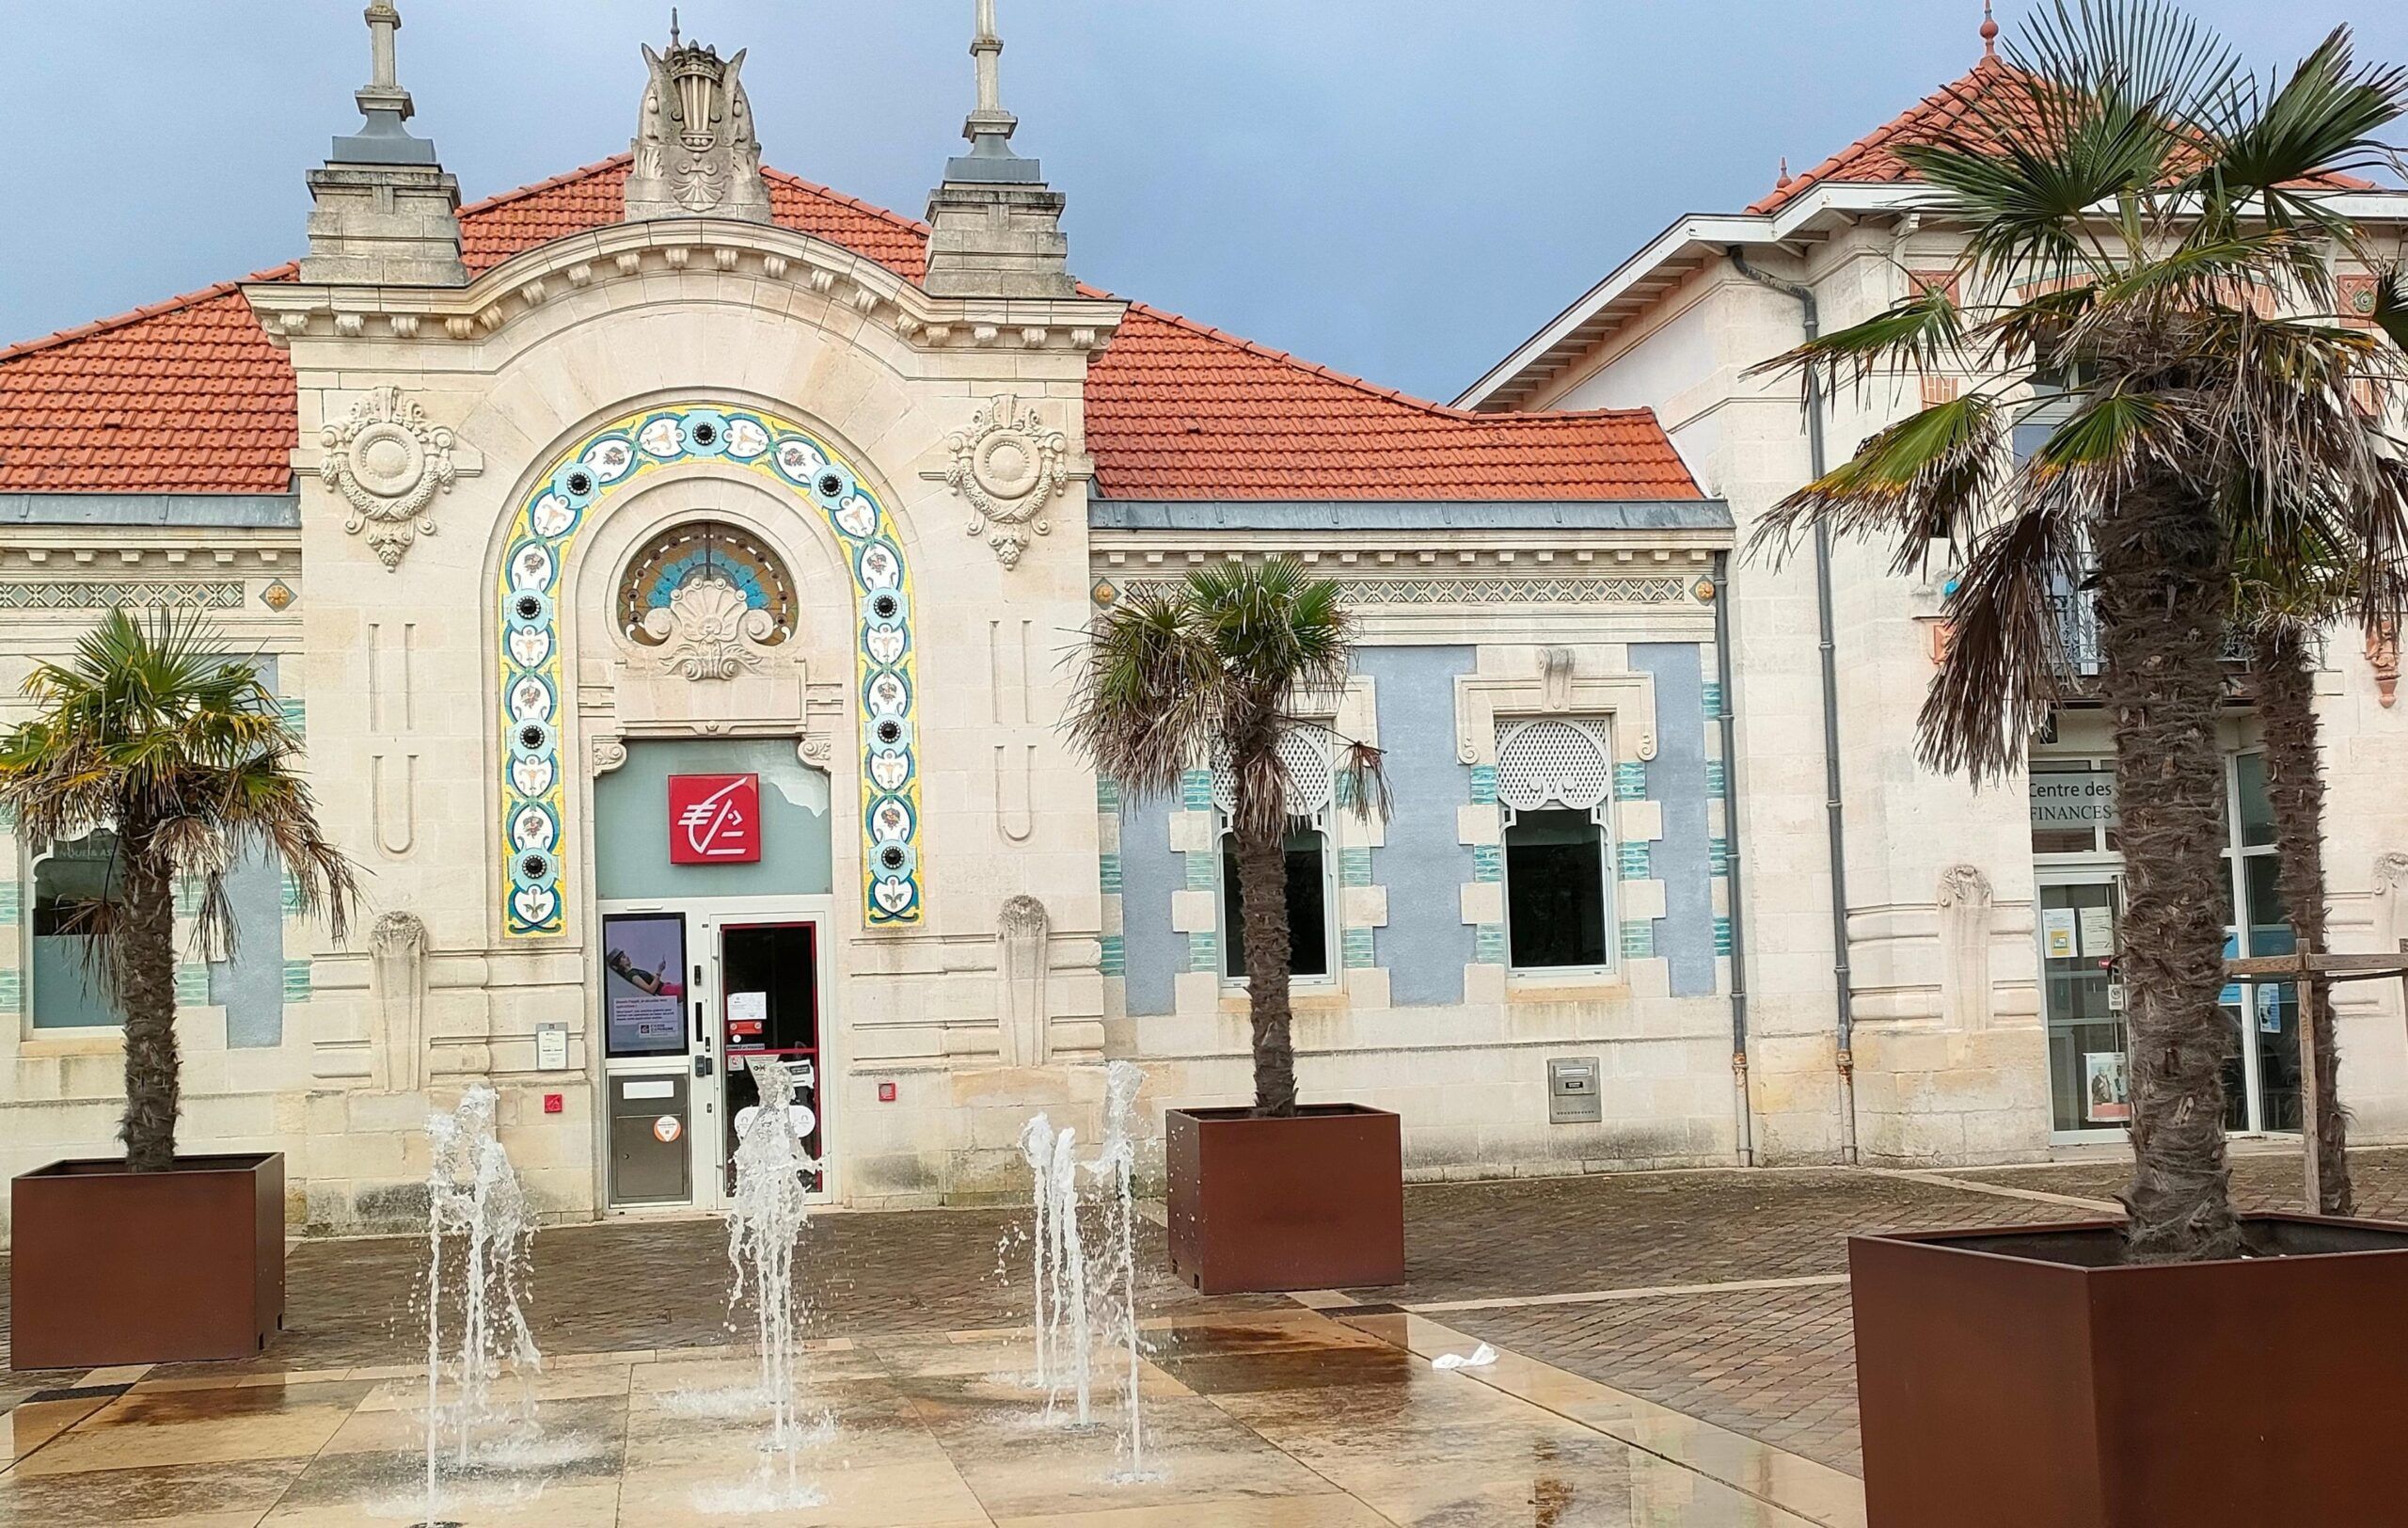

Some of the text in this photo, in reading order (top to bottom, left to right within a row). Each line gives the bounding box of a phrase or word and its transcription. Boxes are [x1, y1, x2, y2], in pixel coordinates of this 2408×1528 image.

[2030, 781, 2112, 798] Centre des
[2031, 804, 2112, 820] FINANCES
